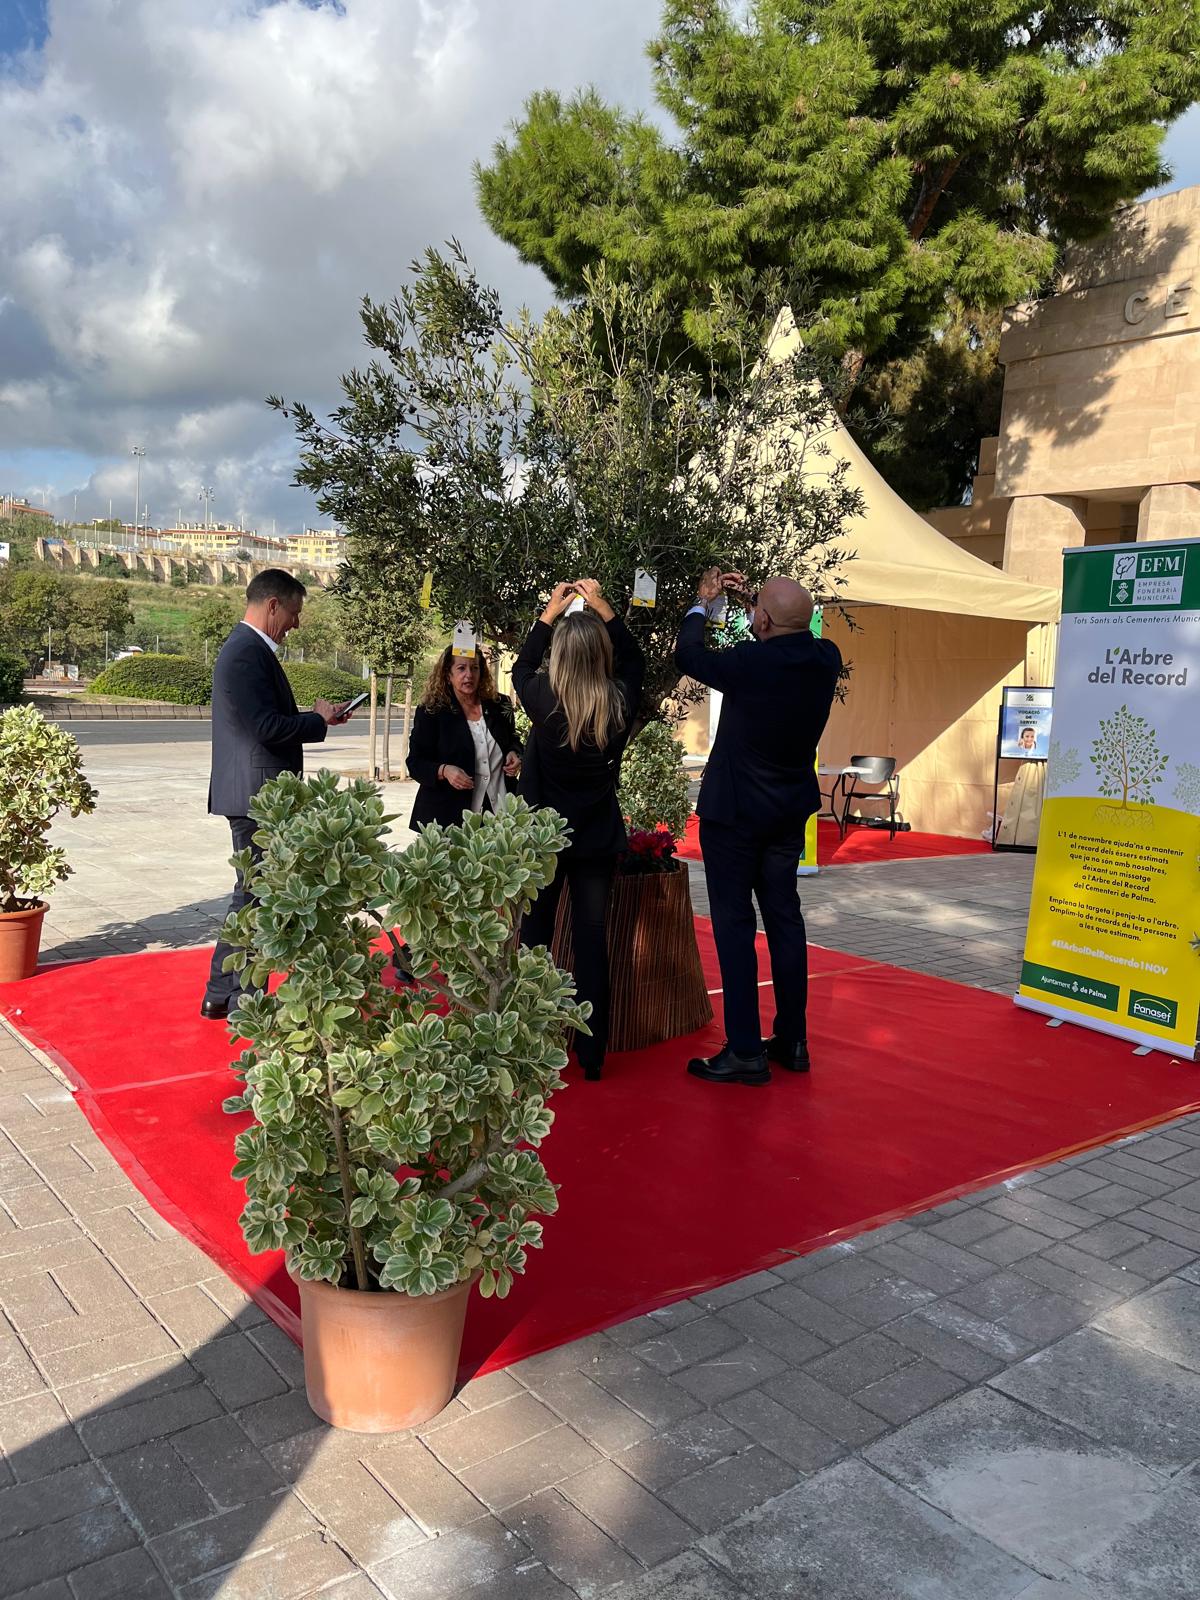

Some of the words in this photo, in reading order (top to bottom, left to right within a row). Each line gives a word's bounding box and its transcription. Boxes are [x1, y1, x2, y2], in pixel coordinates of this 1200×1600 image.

[1141, 556, 1181, 573] EFM
[1074, 616, 1087, 625] Tots
[1090, 616, 1110, 624] Sants
[1112, 616, 1124, 624] als
[1126, 616, 1170, 624] Cementeris
[1106, 647, 1174, 666] L'Arbre
[1088, 667, 1116, 684] del
[1122, 668, 1188, 686] Record
[1078, 835, 1112, 845] novembre
[1114, 840, 1143, 850] ajuda'ns
[1152, 847, 1184, 856] mantenir
[1078, 844, 1099, 853] record
[1139, 854, 1169, 864] estimats
[1083, 864, 1108, 874] deixant
[1120, 871, 1151, 882] missatge
[1132, 864, 1167, 876] nosaltres,
[1087, 874, 1110, 885] l'Arbre
[1124, 882, 1150, 892] Record
[1086, 884, 1119, 896] Cementeri
[1131, 893, 1157, 904] Palma.
[1050, 906, 1084, 919] Omplim-lo
[1095, 916, 1120, 927] records
[1143, 928, 1177, 939] persones
[1086, 904, 1110, 915] targeta
[1115, 911, 1145, 922] penja-la
[1153, 917, 1180, 930] l'arbre.
[1110, 930, 1142, 941] estimam.
[1040, 976, 1071, 990] Ajuntament
[1080, 986, 1088, 994] de
[1088, 988, 1107, 999] Palma
[1134, 1002, 1172, 1023] Panasef
